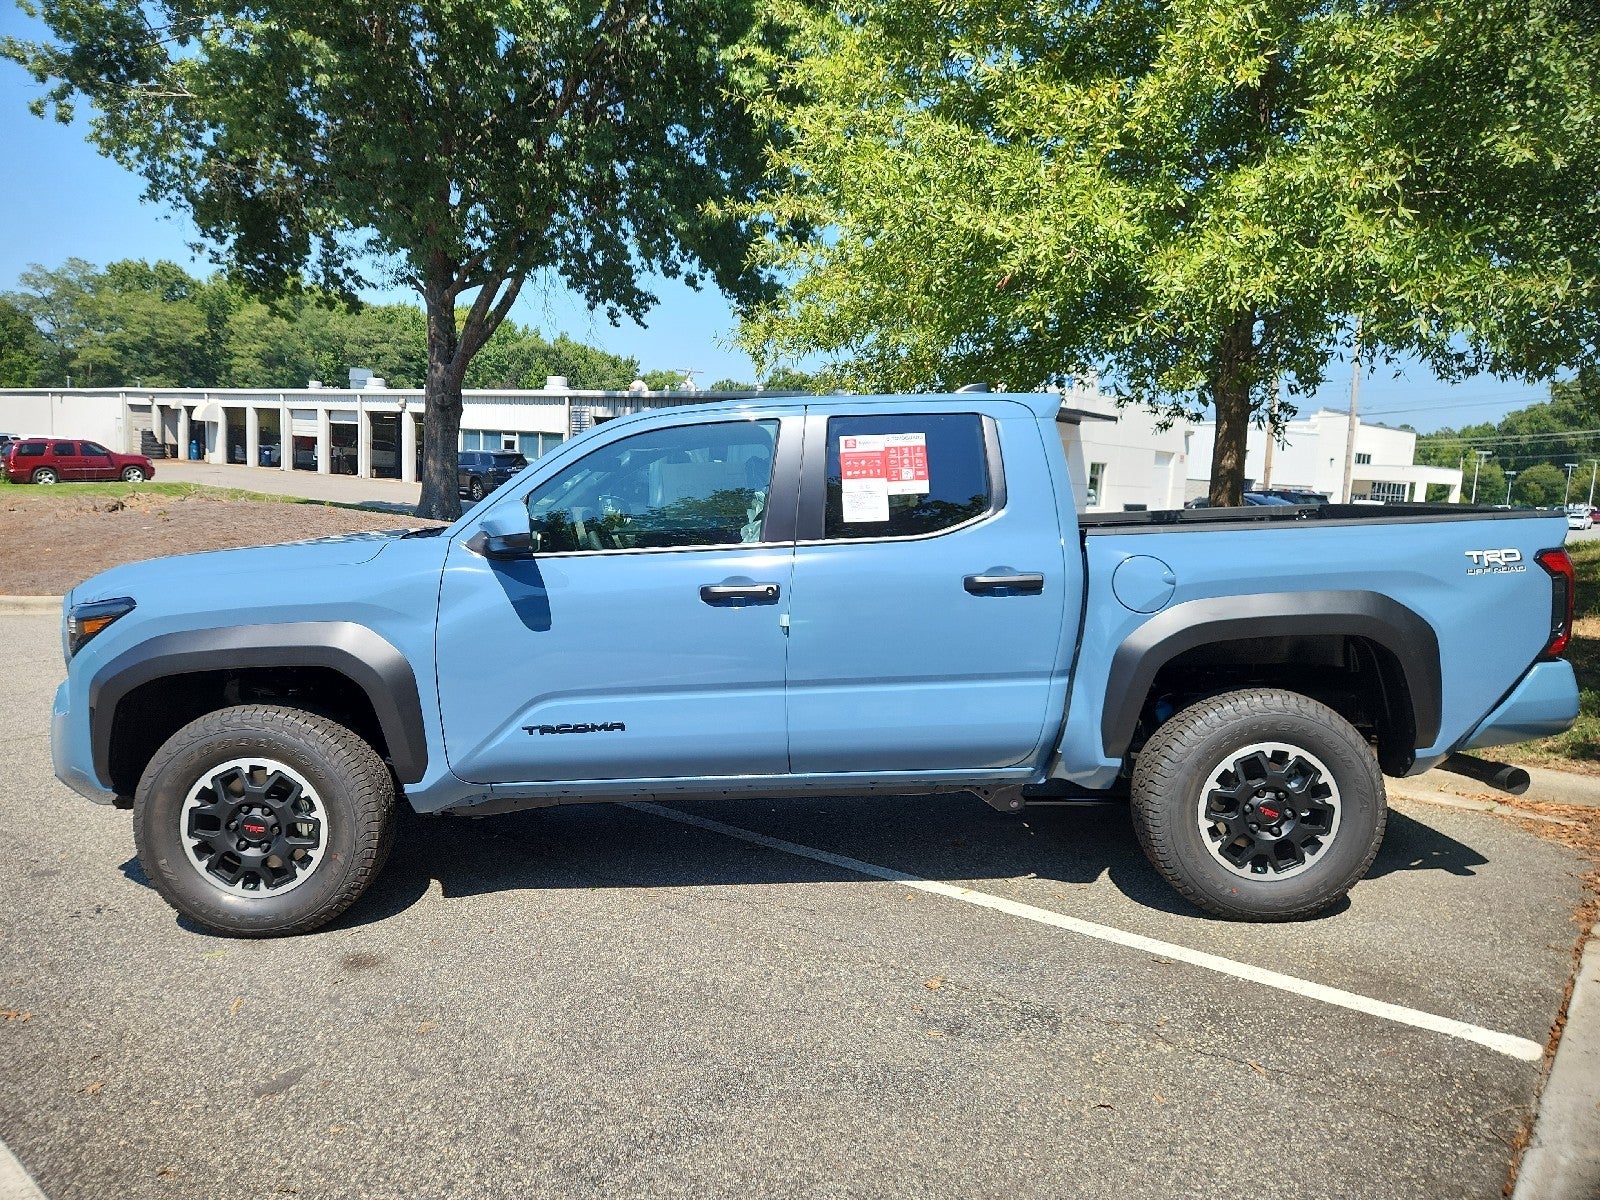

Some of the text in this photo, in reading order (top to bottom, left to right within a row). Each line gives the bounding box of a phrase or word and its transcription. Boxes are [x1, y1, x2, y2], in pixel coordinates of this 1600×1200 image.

[1464, 548, 1522, 567] TRD
[1466, 568, 1491, 576] OFF
[521, 721, 626, 736] TACOMA
[1259, 806, 1279, 818] TRD
[243, 824, 266, 834] TRD
